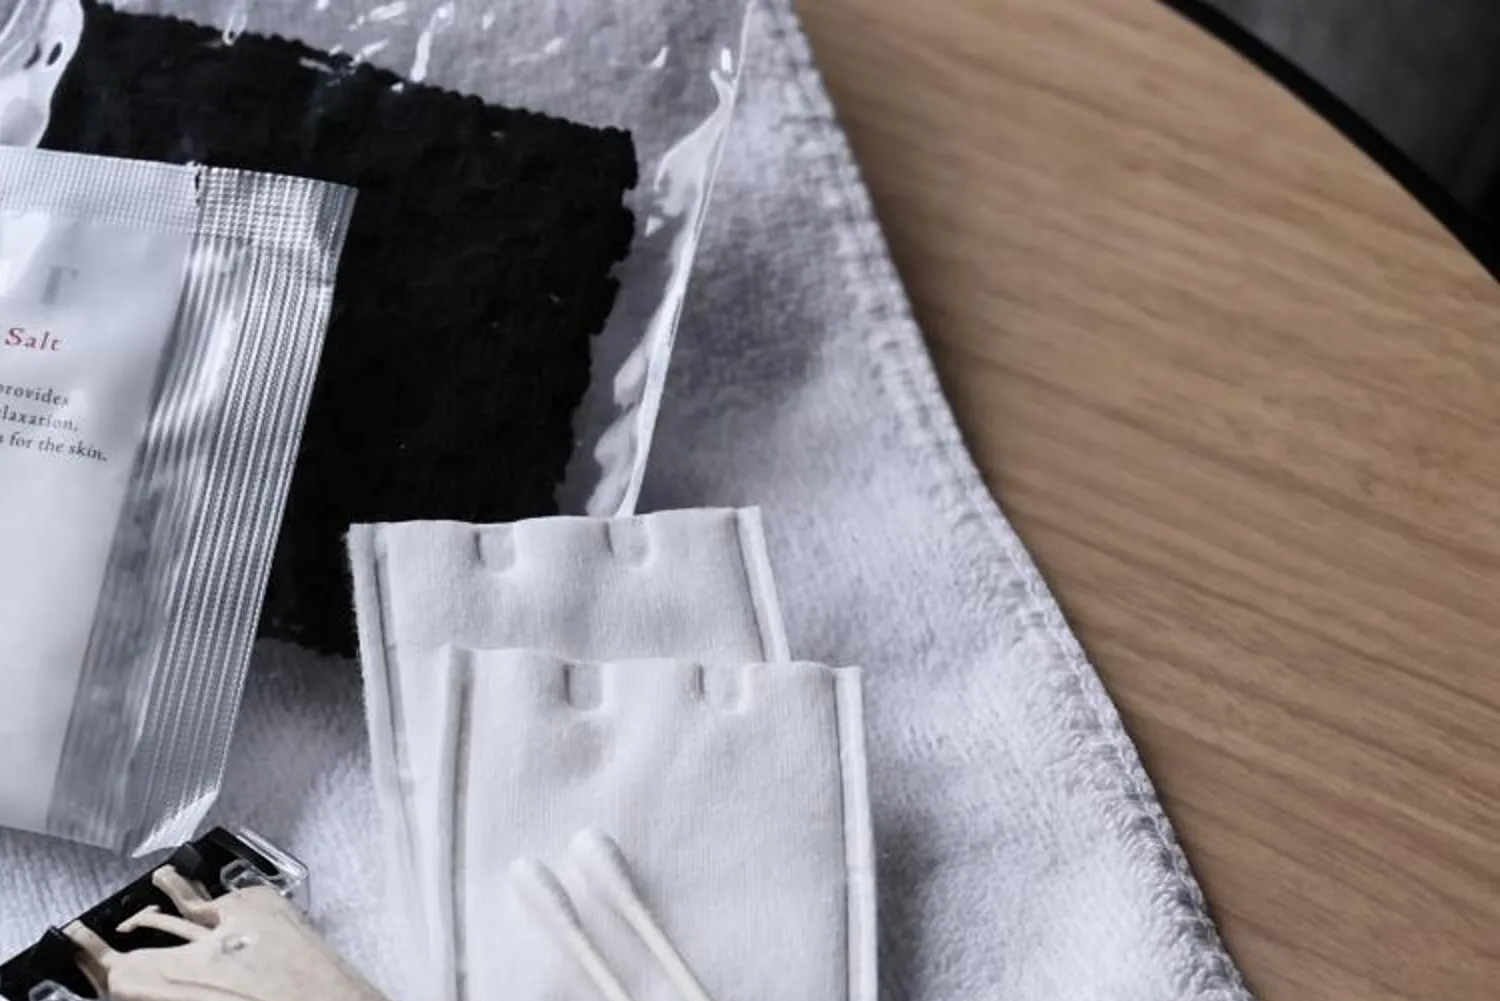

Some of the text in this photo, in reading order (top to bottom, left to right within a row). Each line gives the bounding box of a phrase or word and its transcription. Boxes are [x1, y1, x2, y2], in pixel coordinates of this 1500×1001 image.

[4, 327, 64, 352] Salt
[8, 431, 33, 450] for
[37, 437, 65, 453] the
